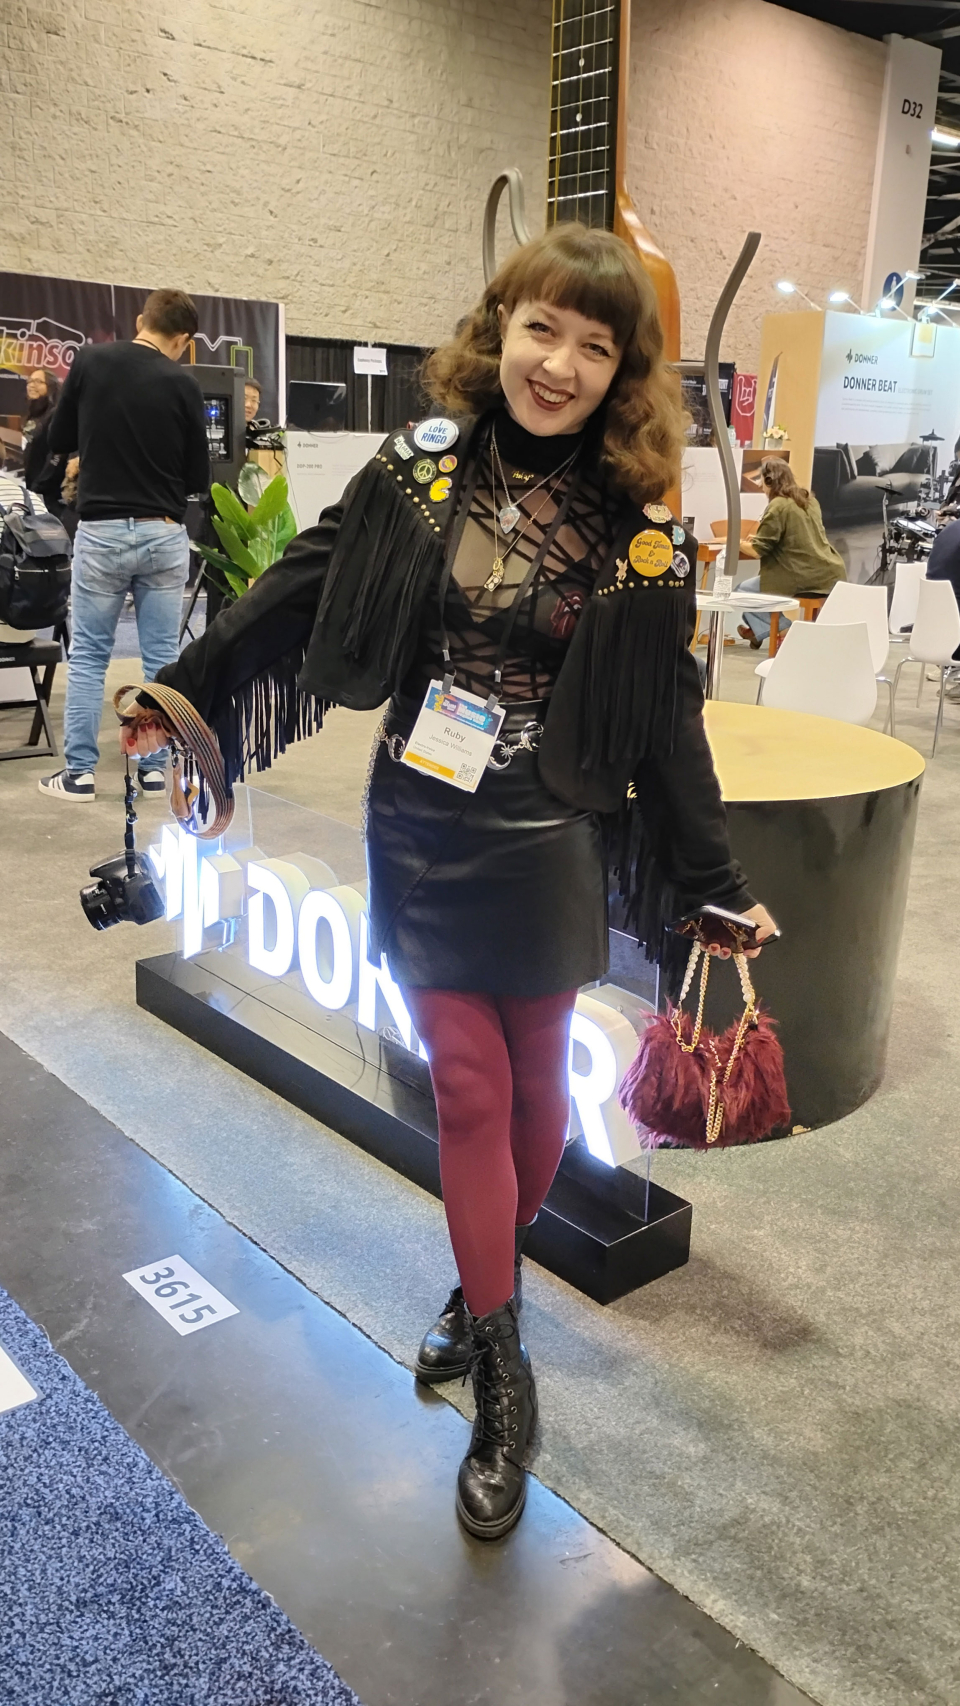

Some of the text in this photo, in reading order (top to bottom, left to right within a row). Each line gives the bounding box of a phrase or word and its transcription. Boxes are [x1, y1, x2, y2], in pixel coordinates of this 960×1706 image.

[901, 98, 923, 119] D32
[854, 353, 878, 365] DONNER
[843, 376, 877, 391] DONNER
[877, 379, 898, 393] BEAT
[428, 425, 448, 434] LOVE
[421, 433, 447, 445] RINGO
[635, 538, 670, 550] Good Times
[633, 555, 649, 564] Rock
[654, 559, 668, 567] Roll
[444, 727, 466, 742] Ruby
[428, 734, 450, 747] Jessica
[450, 741, 473, 757] Williams
[247, 860, 619, 1168] DONR
[139, 1266, 218, 1324] 3615
